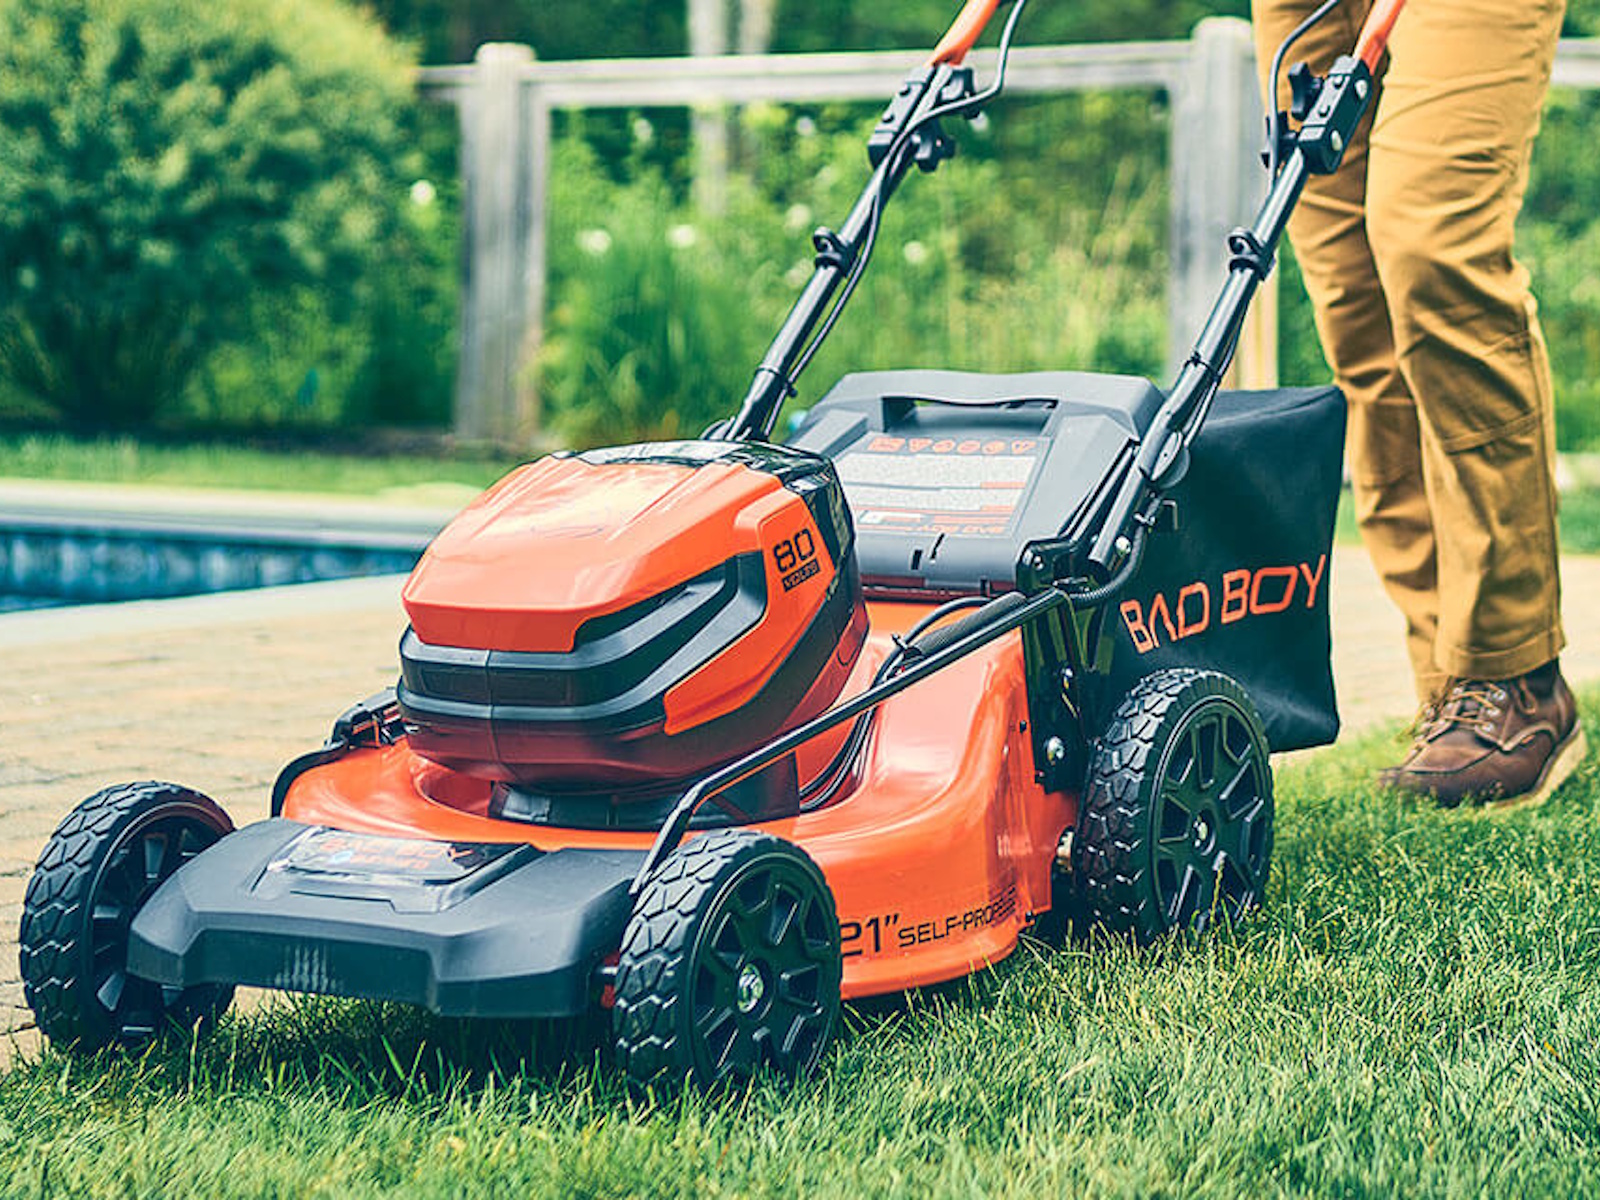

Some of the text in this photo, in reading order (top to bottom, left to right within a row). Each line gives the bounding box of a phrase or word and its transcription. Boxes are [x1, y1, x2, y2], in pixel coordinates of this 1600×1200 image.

[773, 528, 815, 573] 80
[1120, 554, 1326, 654] BAD BOY
